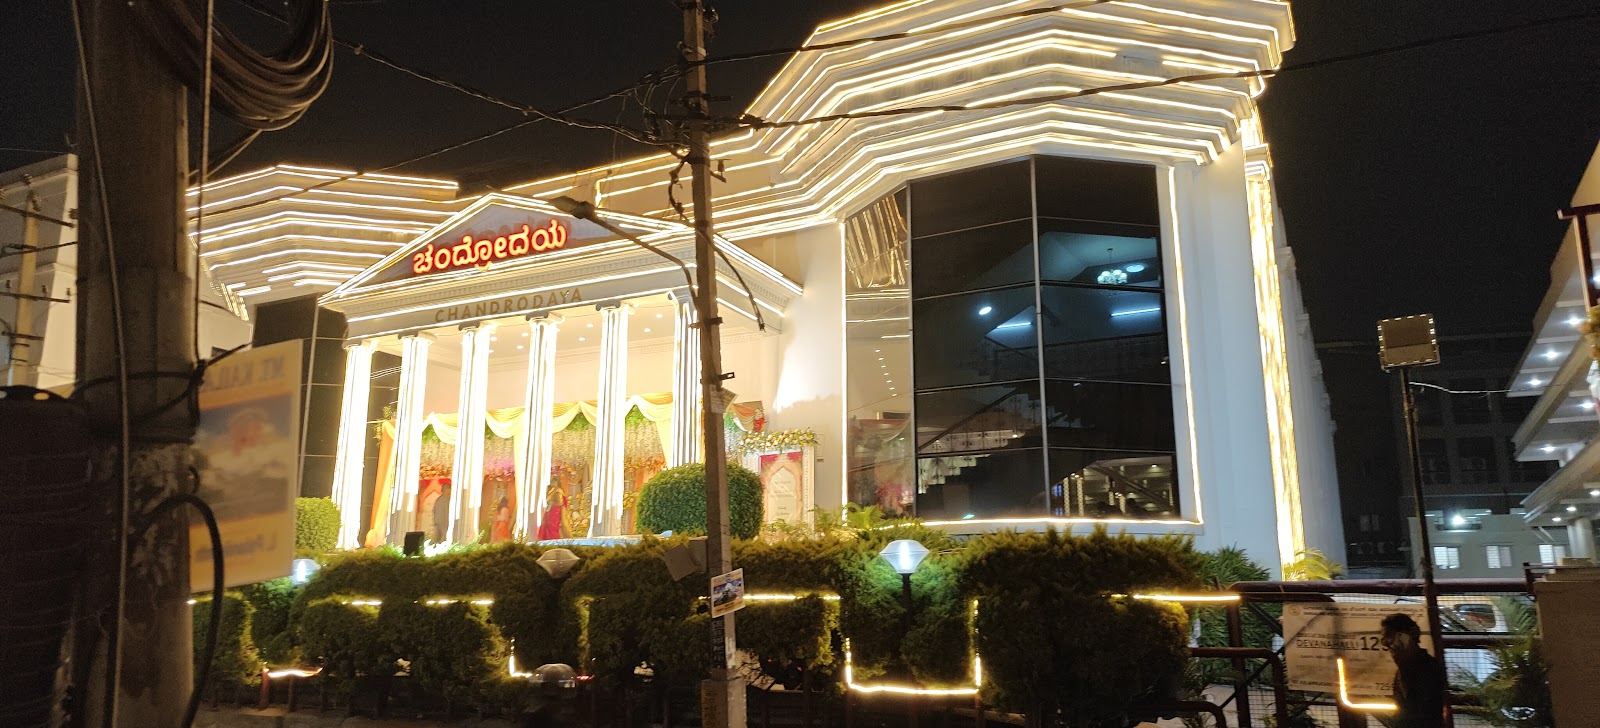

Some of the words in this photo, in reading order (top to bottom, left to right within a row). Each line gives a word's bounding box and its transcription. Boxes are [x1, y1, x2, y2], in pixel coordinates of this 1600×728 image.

[413, 218, 567, 273] ಚಂದ್ರೋದಯ
[435, 287, 583, 323] CHANDRODAYA
[1296, 639, 1358, 649] DEVANAHALLI
